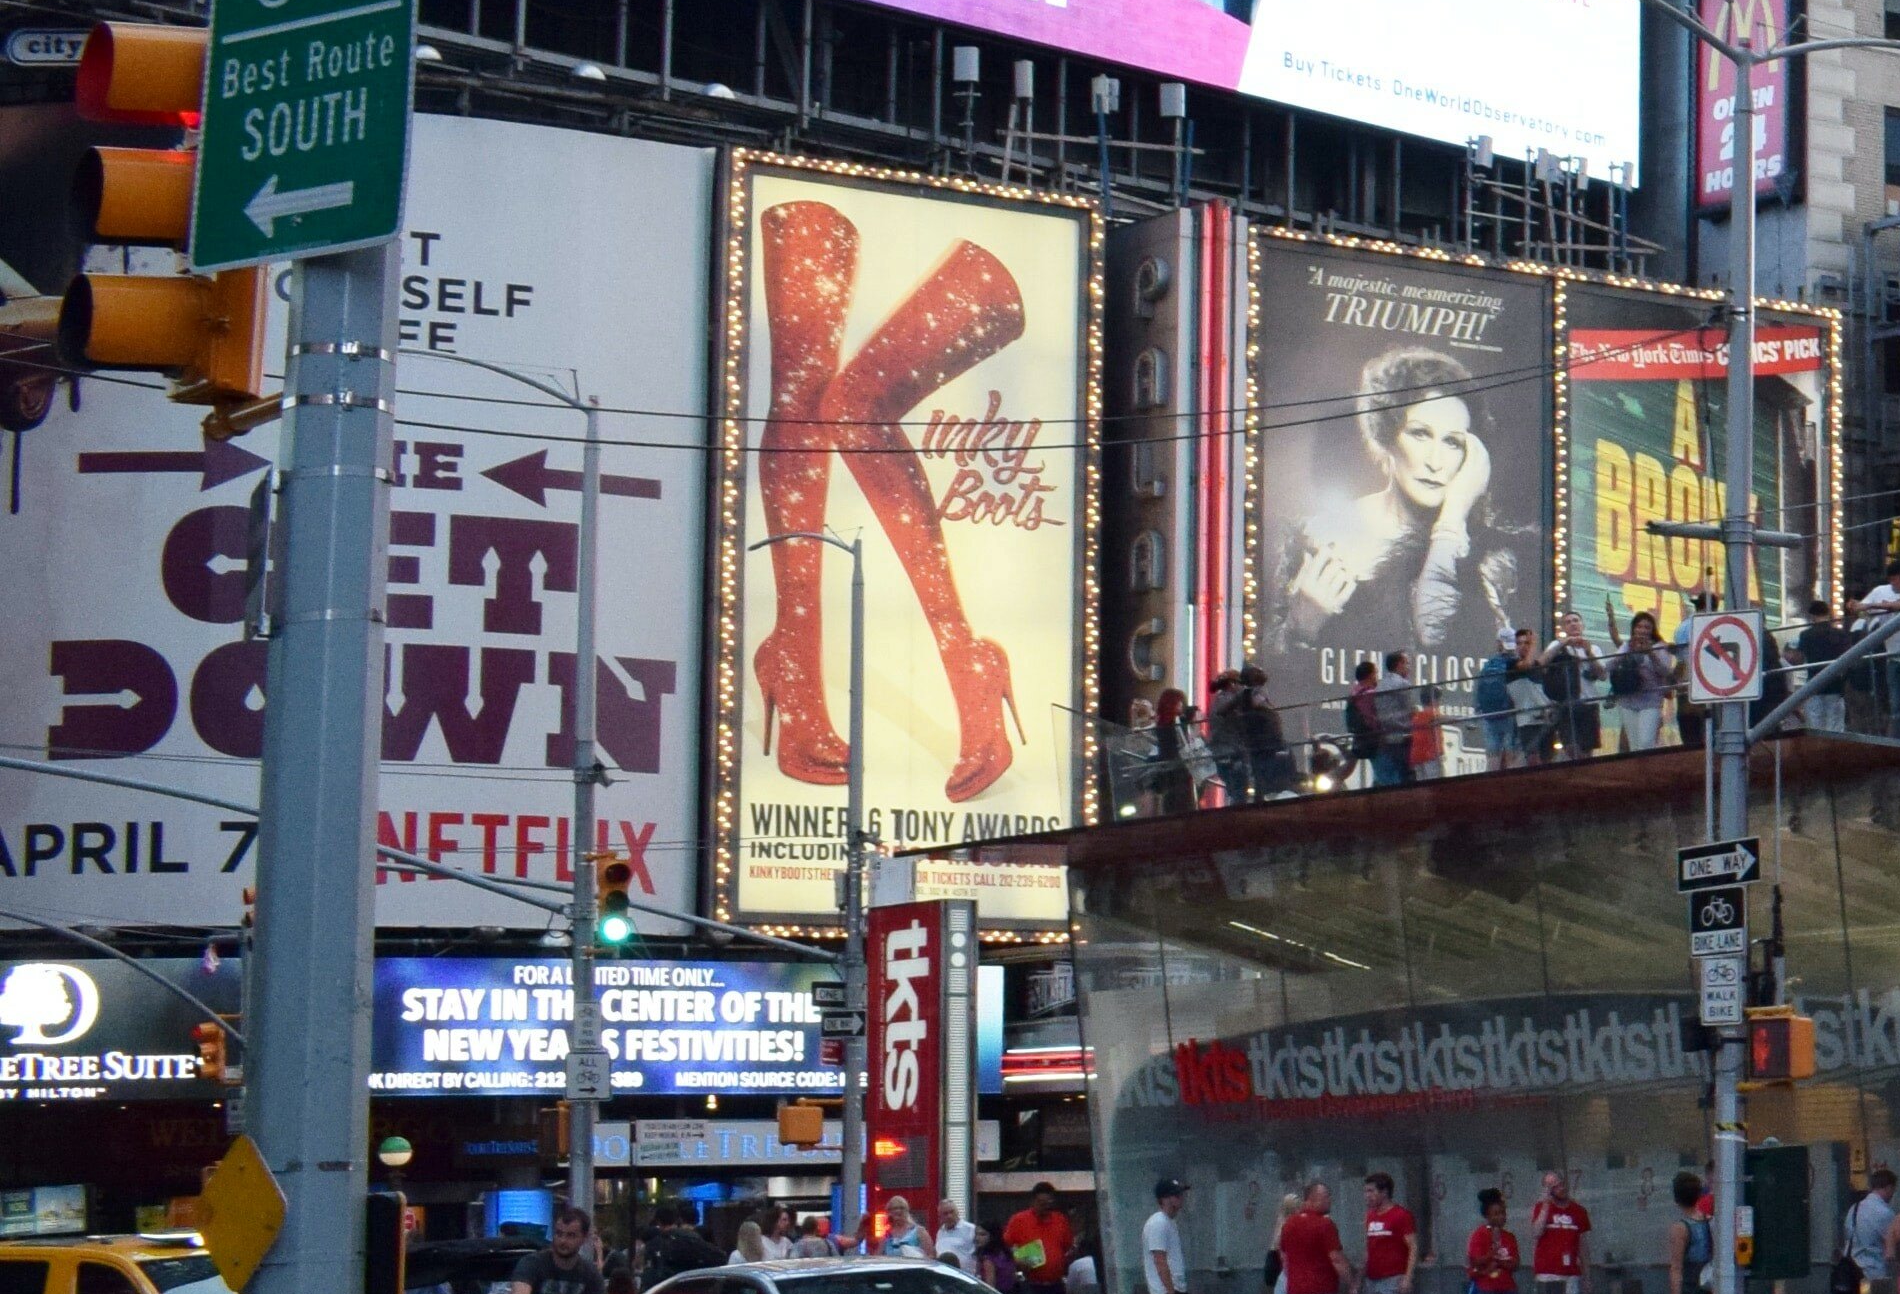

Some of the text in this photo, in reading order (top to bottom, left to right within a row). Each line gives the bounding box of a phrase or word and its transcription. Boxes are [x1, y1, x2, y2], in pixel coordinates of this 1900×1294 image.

[222, 34, 395, 99] Best Route
[1283, 50, 1316, 78] Buy
[242, 86, 368, 162] SOUTH
[1705, 155, 1781, 193] HORS
[1632, 344, 1668, 368] York
[1784, 337, 1821, 360] PICK
[1671, 379, 1701, 466] A
[937, 469, 1066, 531] Boots
[868, 808, 882, 838] 6
[891, 809, 955, 843] TONY
[962, 812, 1061, 844] AWARDS
[376, 811, 657, 894] NETFLIX
[1689, 853, 1747, 876] ONE WAY
[1694, 932, 1741, 951] BIKE LANE
[514, 966, 550, 985] FOR
[632, 966, 669, 986] TIME
[402, 988, 822, 1024] STAY IN CENTER OF THE
[1707, 990, 1736, 1001] WALK
[1709, 1005, 1733, 1016] BIKE
[885, 919, 929, 1110] tkts
[424, 1028, 804, 1062] NEW FESTIVITIES!
[579, 1058, 597, 1068] ALL
[387, 1072, 440, 1089] DIRECT
[442, 1073, 461, 1089] BY
[464, 1073, 533, 1089] CALLING:
[676, 1072, 738, 1088] MENTION
[740, 1073, 794, 1088] SOURCE
[796, 1073, 838, 1088] CODE:
